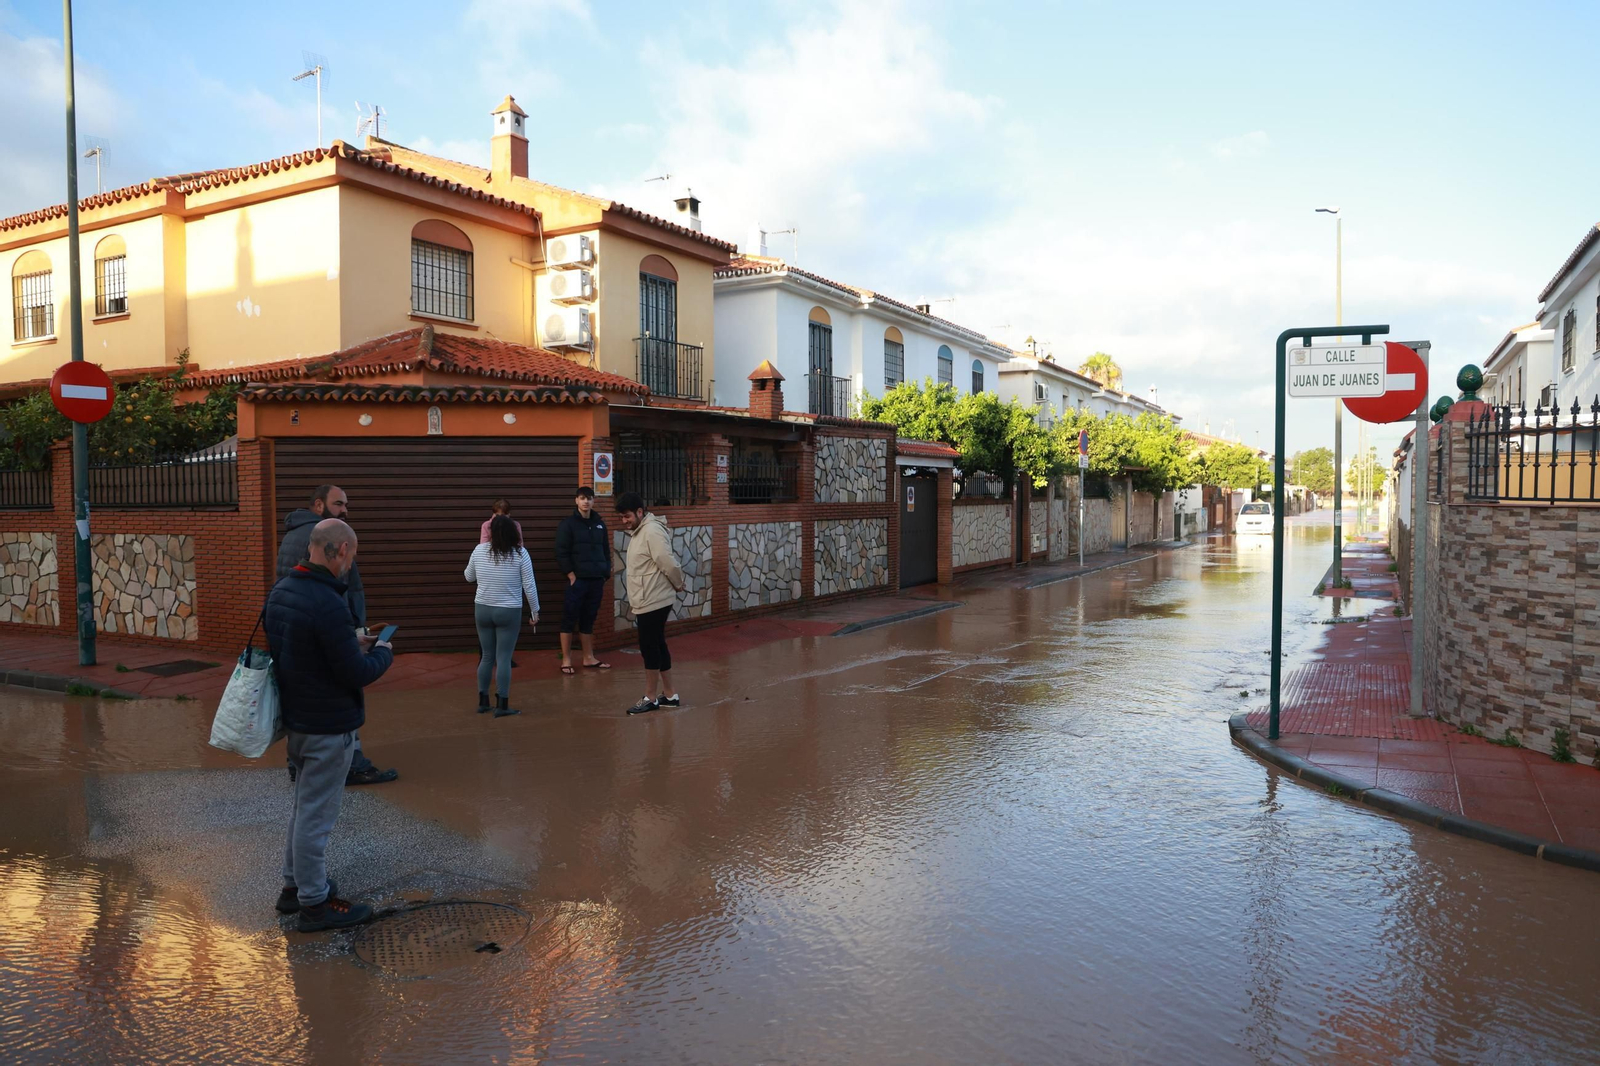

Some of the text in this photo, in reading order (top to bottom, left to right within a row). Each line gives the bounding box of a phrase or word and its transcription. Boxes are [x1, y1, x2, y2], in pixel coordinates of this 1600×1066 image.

[1326, 350, 1355, 362] CALLE
[1293, 373, 1379, 387] JUAN DE JUANES
